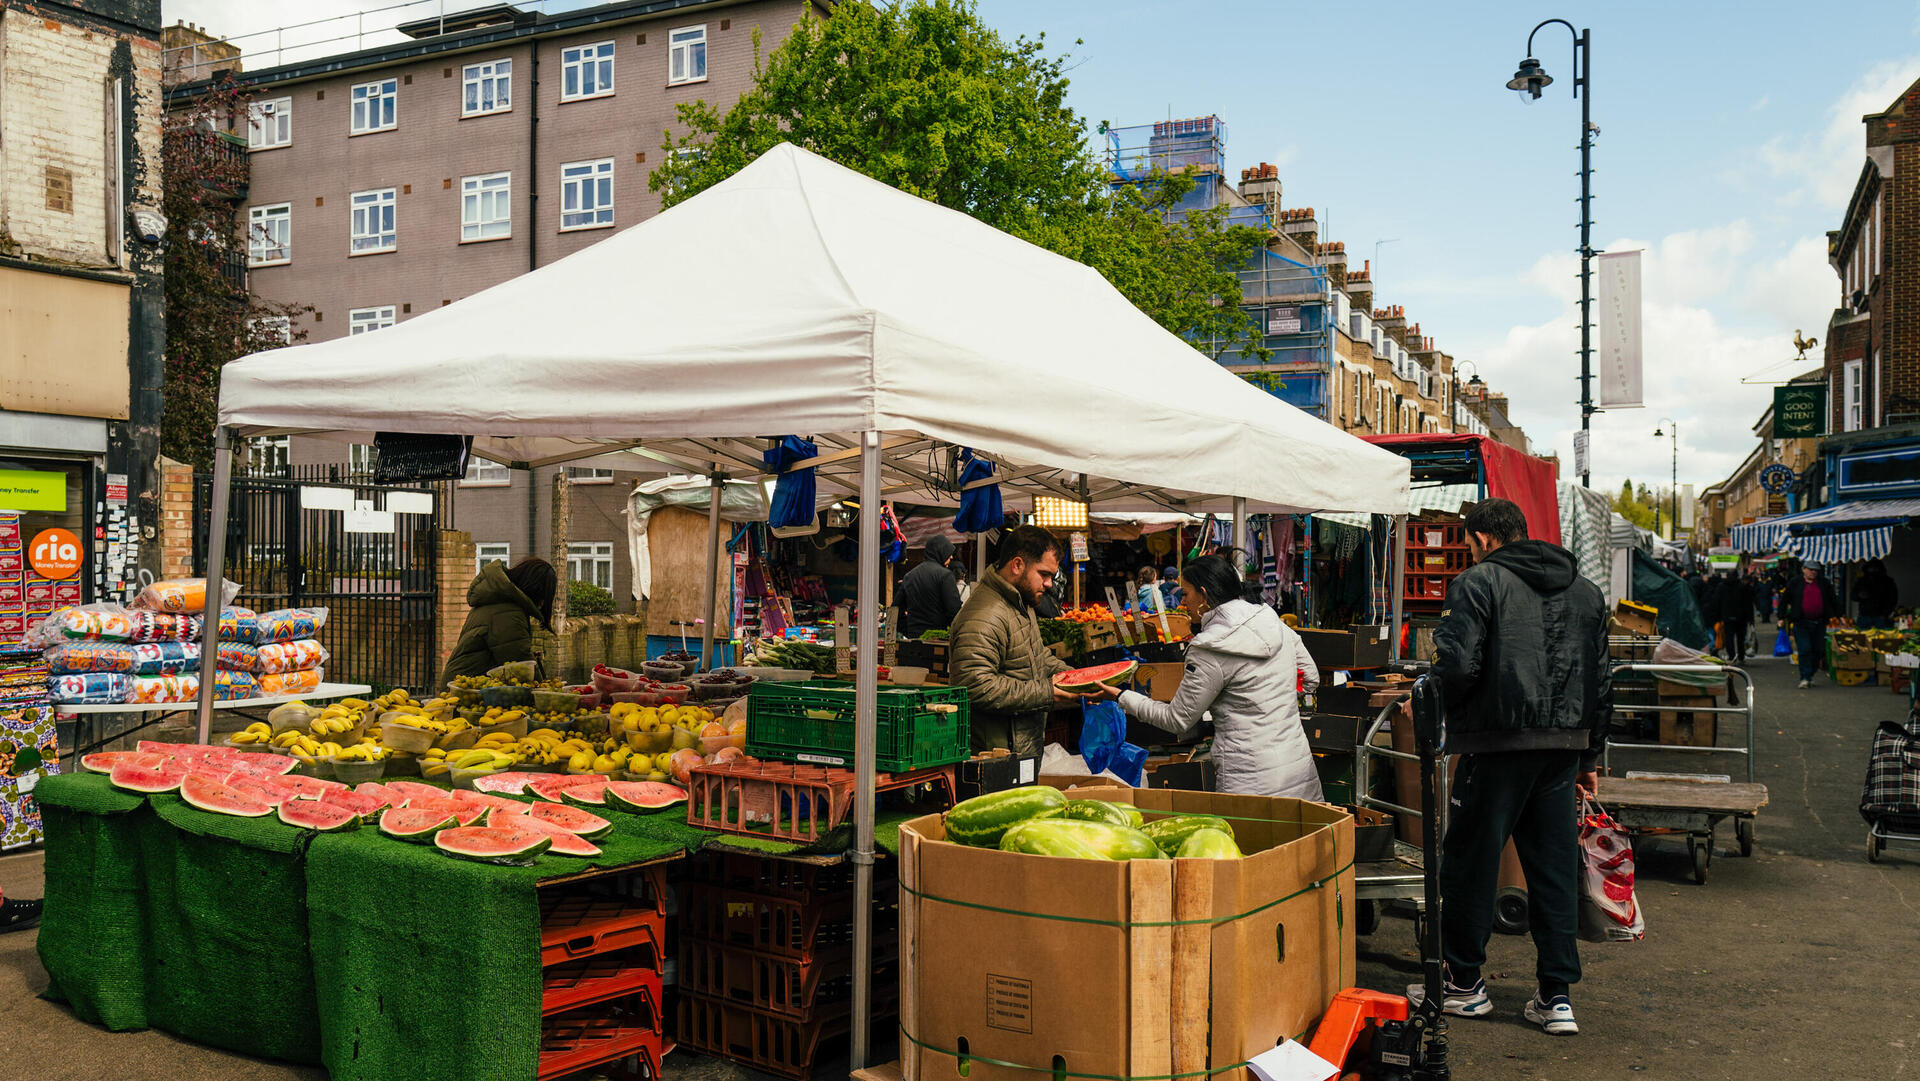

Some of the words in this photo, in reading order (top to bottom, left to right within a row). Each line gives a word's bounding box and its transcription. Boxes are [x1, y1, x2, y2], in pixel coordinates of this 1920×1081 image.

[1614, 296, 1627, 343] STREET
[1614, 348, 1628, 396] MARKET
[1783, 411, 1815, 420] INTENT
[1785, 402, 1814, 411] GOOD
[35, 534, 77, 560] ria
